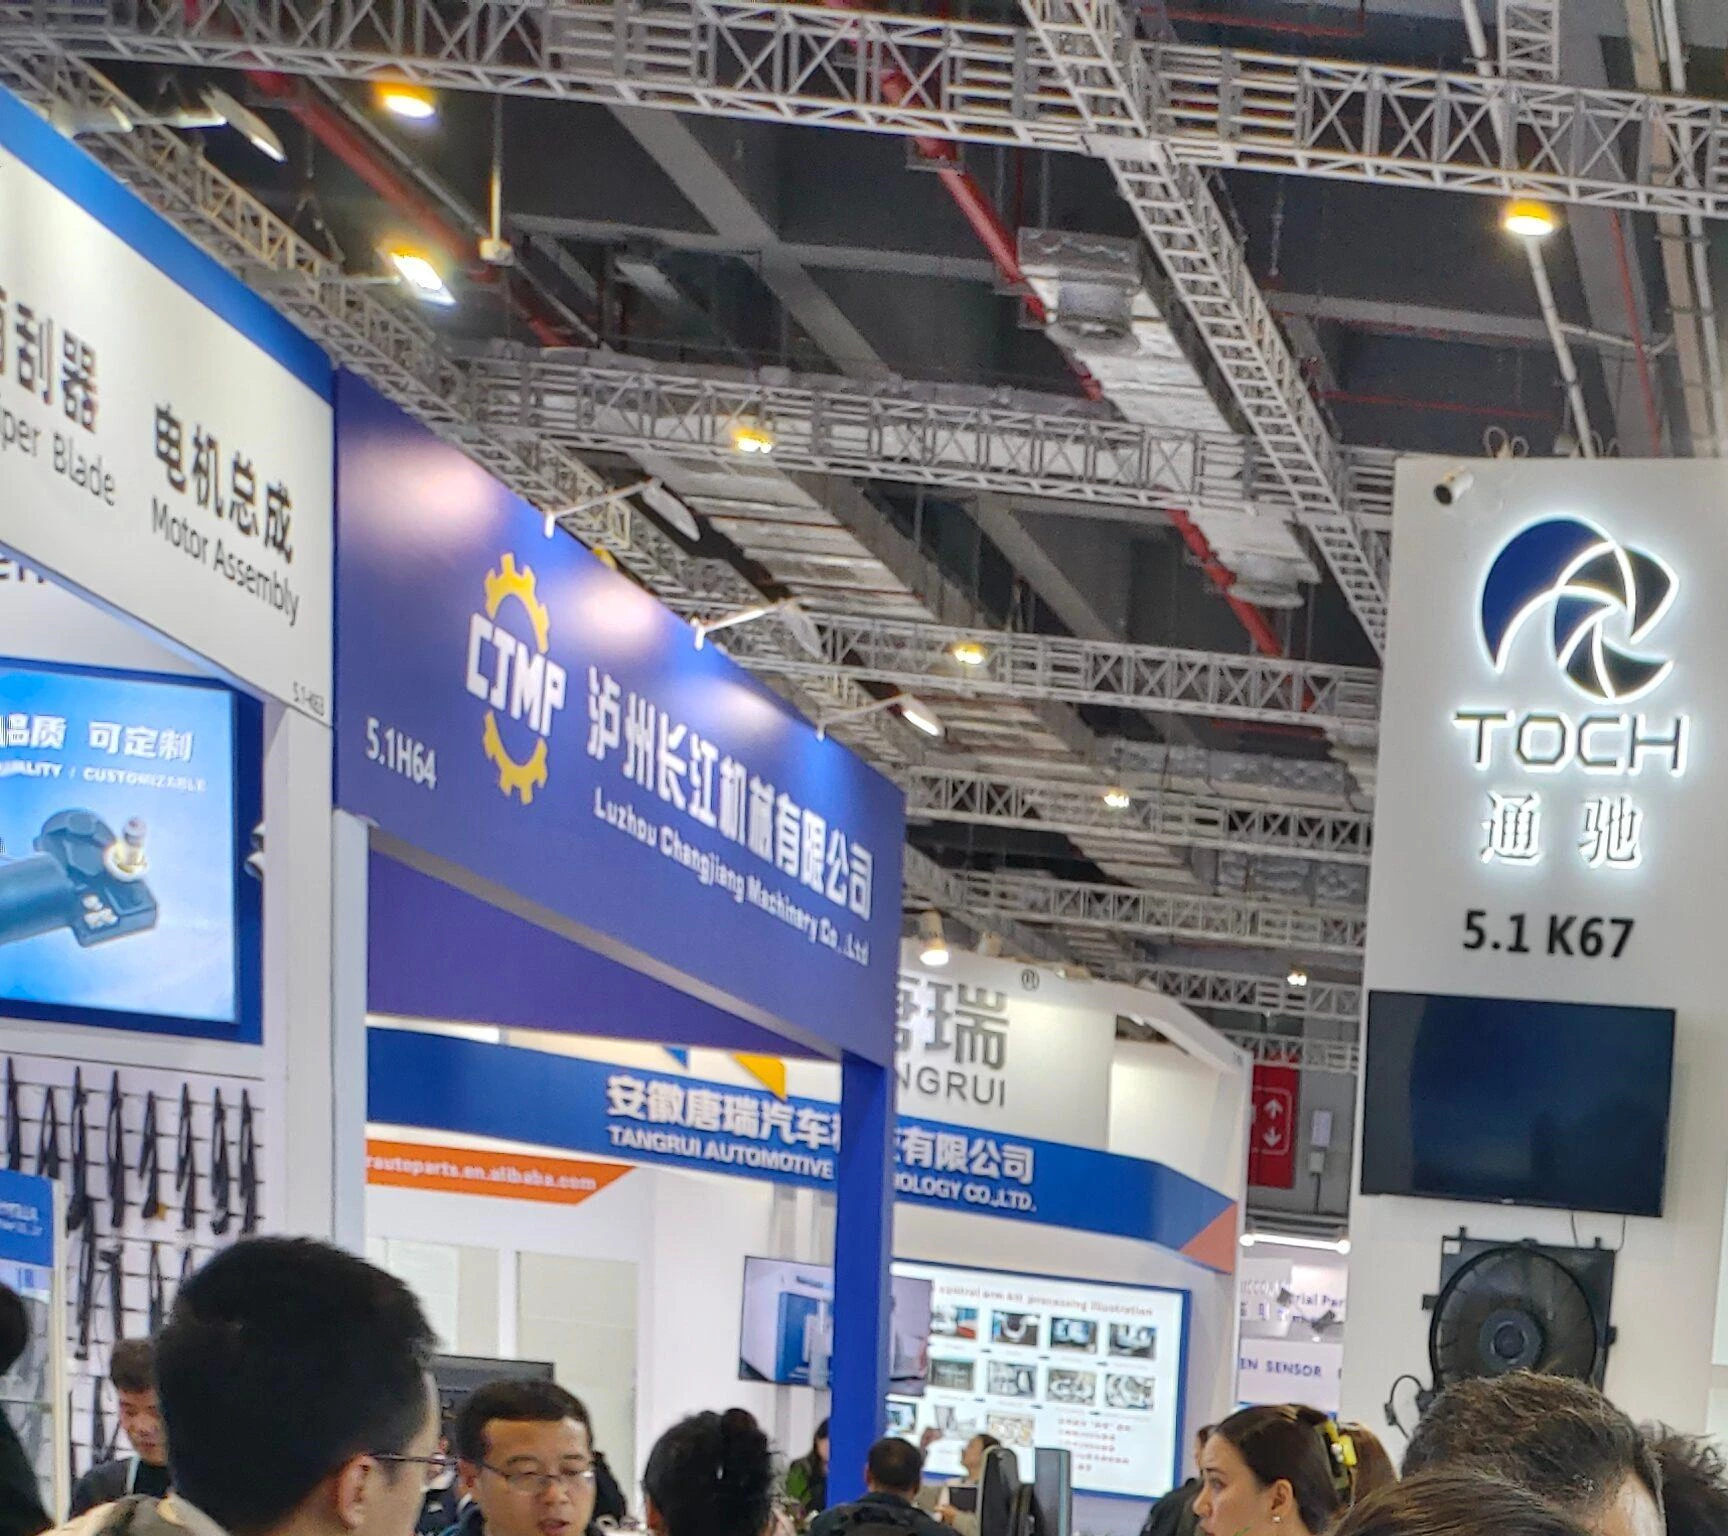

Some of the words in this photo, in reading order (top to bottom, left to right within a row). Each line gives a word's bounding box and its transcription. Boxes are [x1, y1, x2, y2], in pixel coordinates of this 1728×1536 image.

[0, 286, 98, 434] 刮器
[53, 432, 115, 507] Blade
[154, 402, 293, 564] 电机总成
[152, 497, 209, 565] Motor
[213, 537, 300, 627] Assembly
[83, 766, 207, 792] CUSTOMIZABLE
[88, 720, 194, 763] 可定制
[366, 715, 438, 790] 5.1H64
[1453, 709, 1689, 776] TOCH
[587, 664, 874, 922] 泸州长江机械有限公司
[1480, 791, 1644, 869] 通驰
[593, 786, 657, 847] Luzhou
[658, 824, 744, 904] Changjiang
[745, 875, 819, 944] Machinery
[1462, 909, 1530, 953] 5.1
[1546, 917, 1635, 959] K67
[896, 973, 1010, 1071] 瑞
[606, 1075, 841, 1153] 安徽唐瑞汽车
[896, 1126, 1035, 1185] 有限公司
[607, 1125, 702, 1159] TANGRUI
[704, 1141, 835, 1180] AUTOMOTIVE
[895, 1172, 962, 1200] OLOGY
[1266, 1359, 1321, 1377] SENSOR
